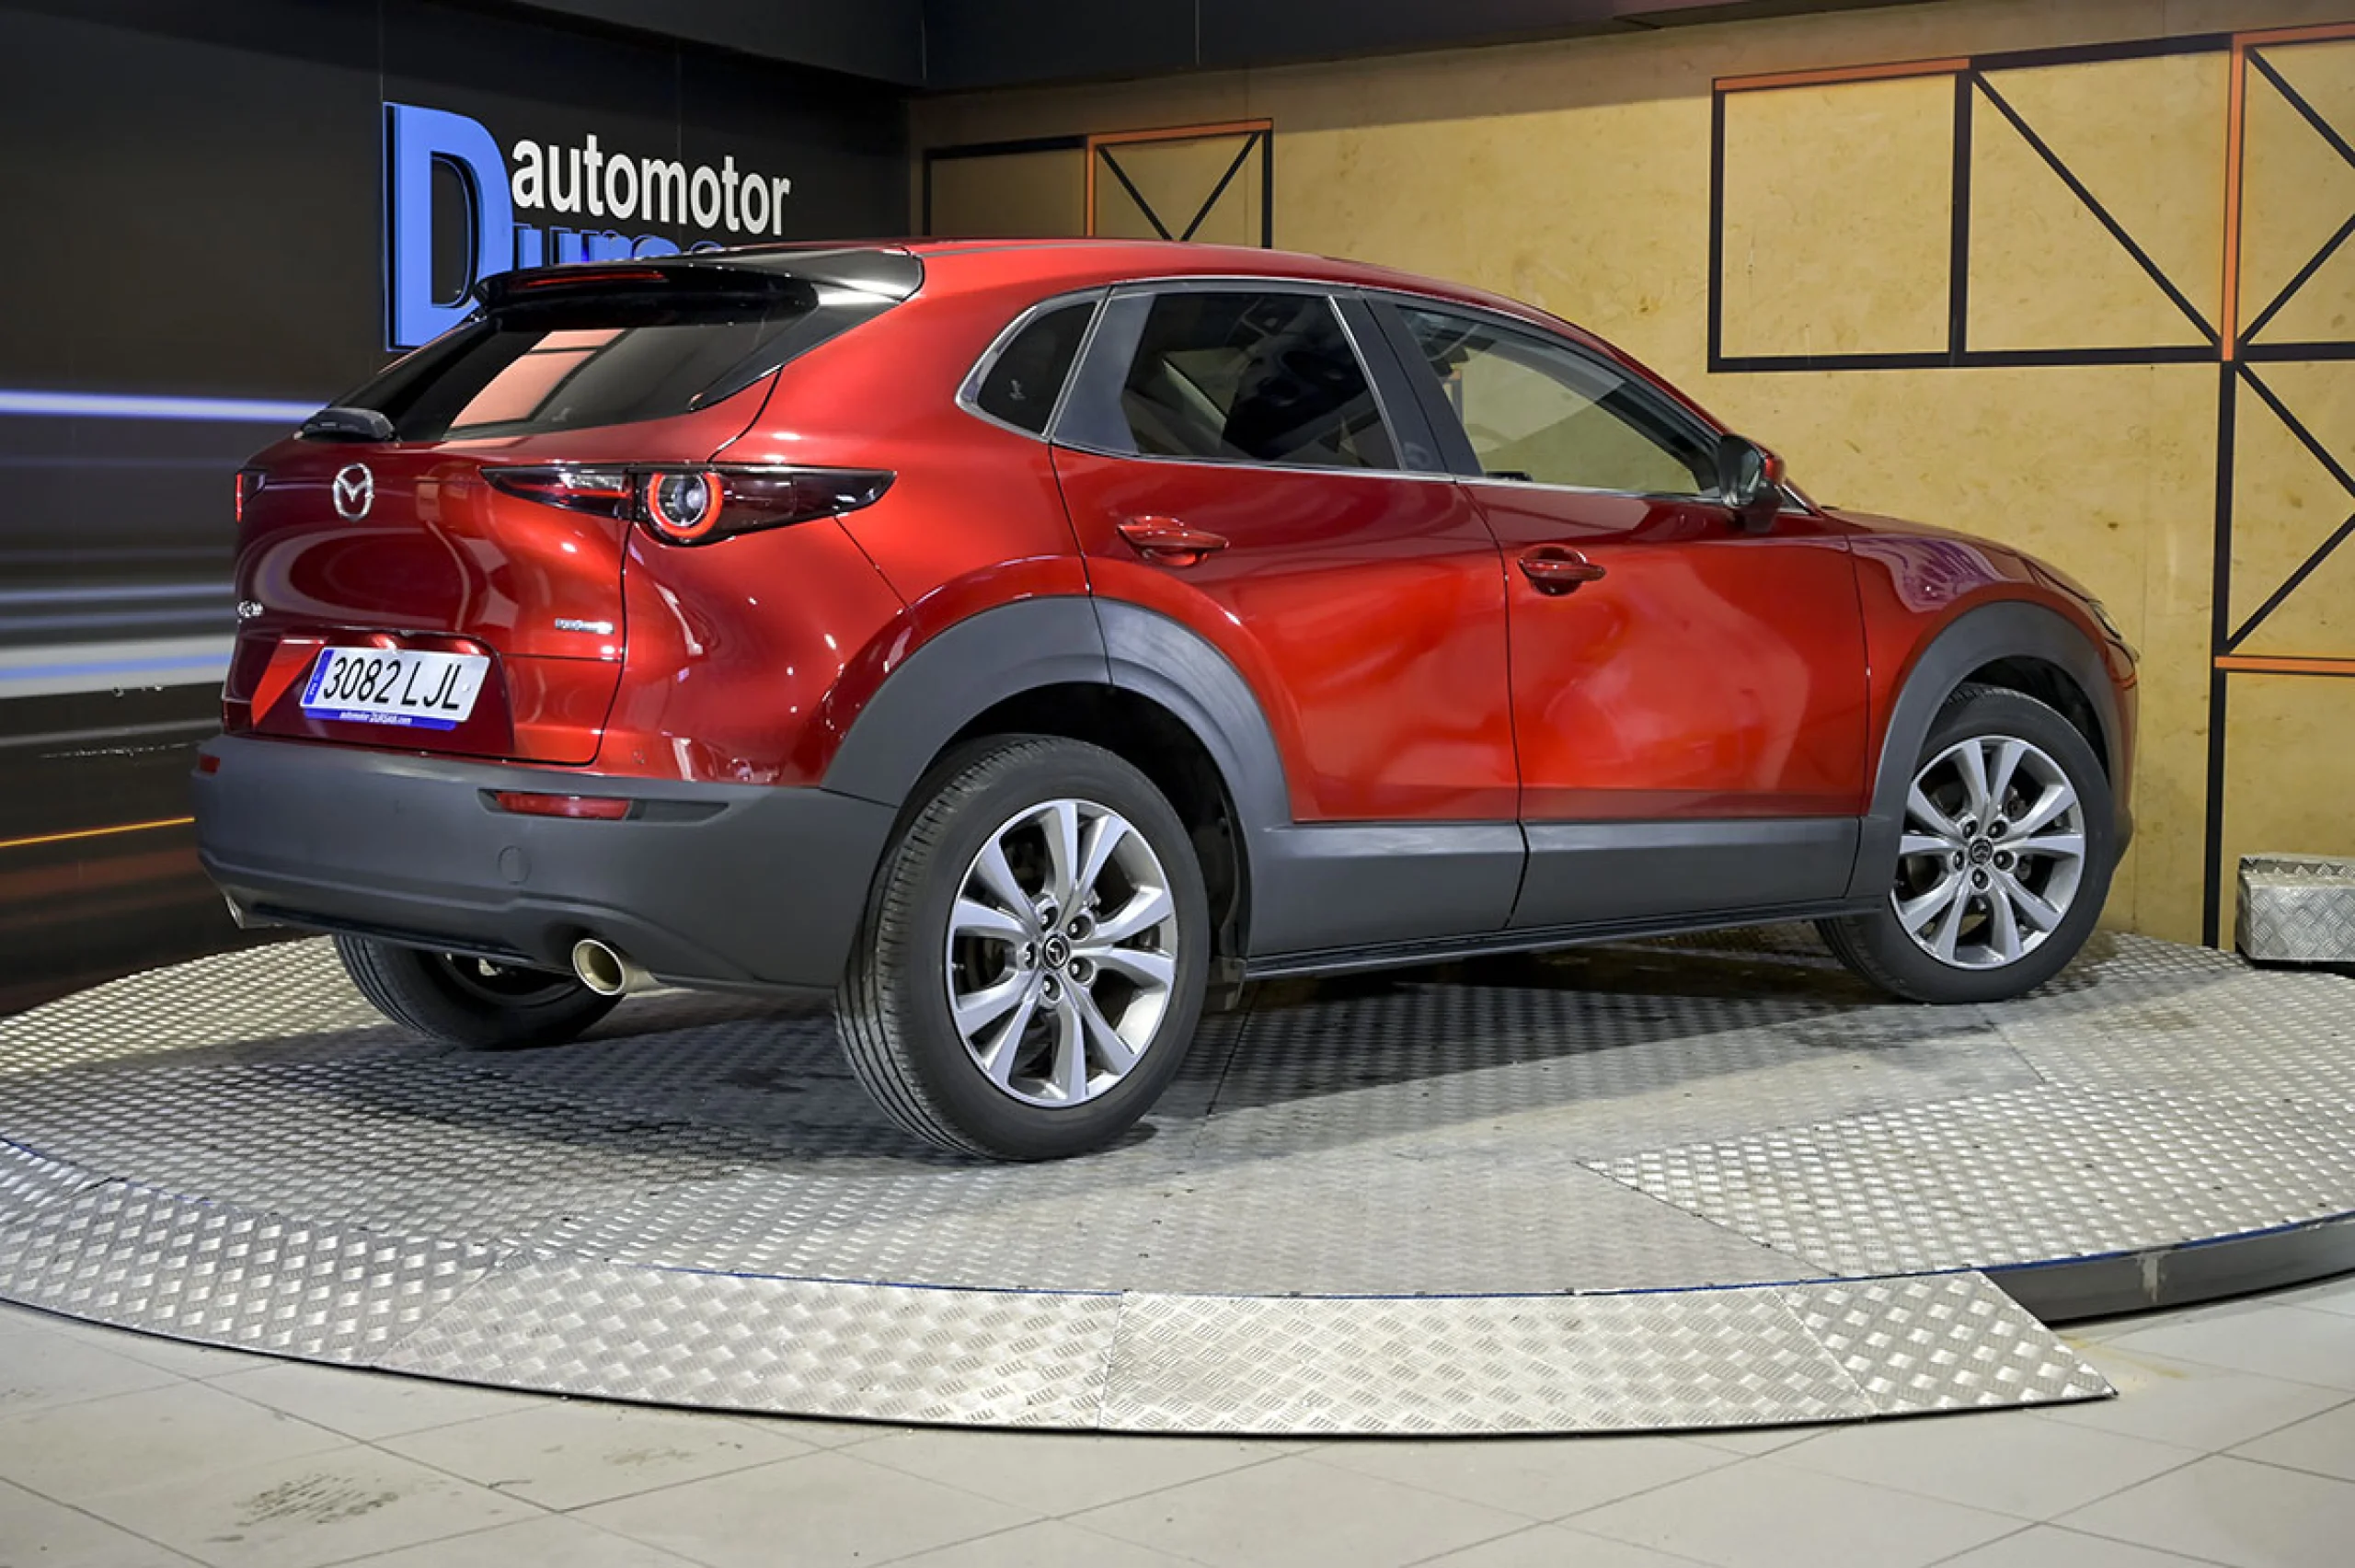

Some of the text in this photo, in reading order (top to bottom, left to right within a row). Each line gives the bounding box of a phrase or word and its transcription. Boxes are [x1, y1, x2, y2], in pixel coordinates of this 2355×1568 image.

[511, 134, 791, 236] automotor
[323, 657, 462, 710] 3082 LJL
